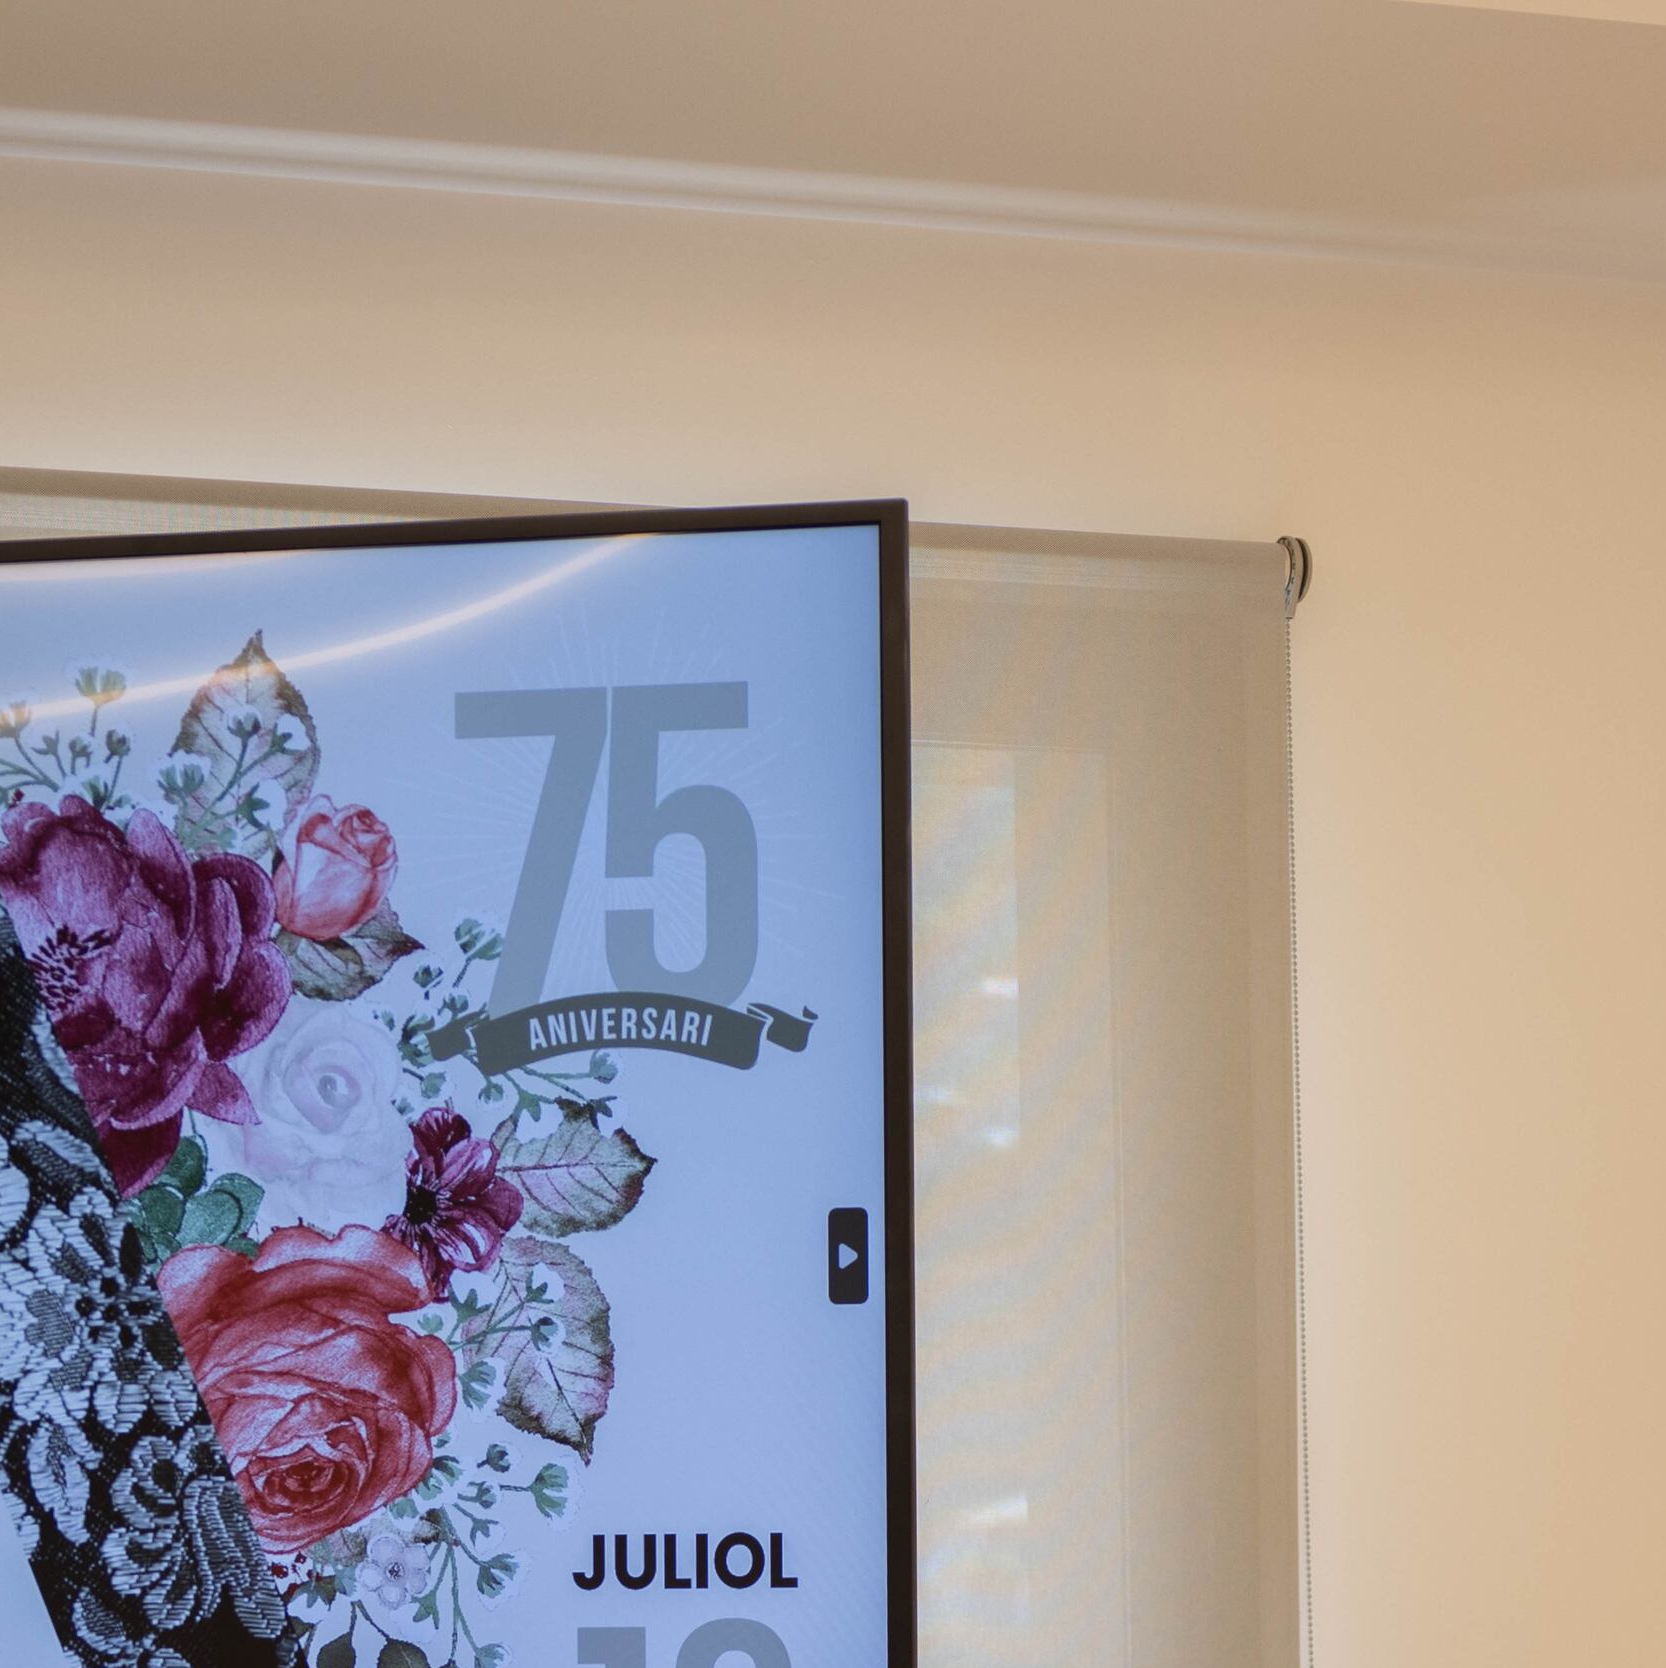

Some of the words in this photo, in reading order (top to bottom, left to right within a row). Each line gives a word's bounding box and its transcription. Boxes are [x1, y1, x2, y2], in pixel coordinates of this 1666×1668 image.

[454, 680, 759, 1020] 75
[529, 1006, 713, 1051] ANIVERSARI
[572, 1531, 799, 1591] JULIOL
